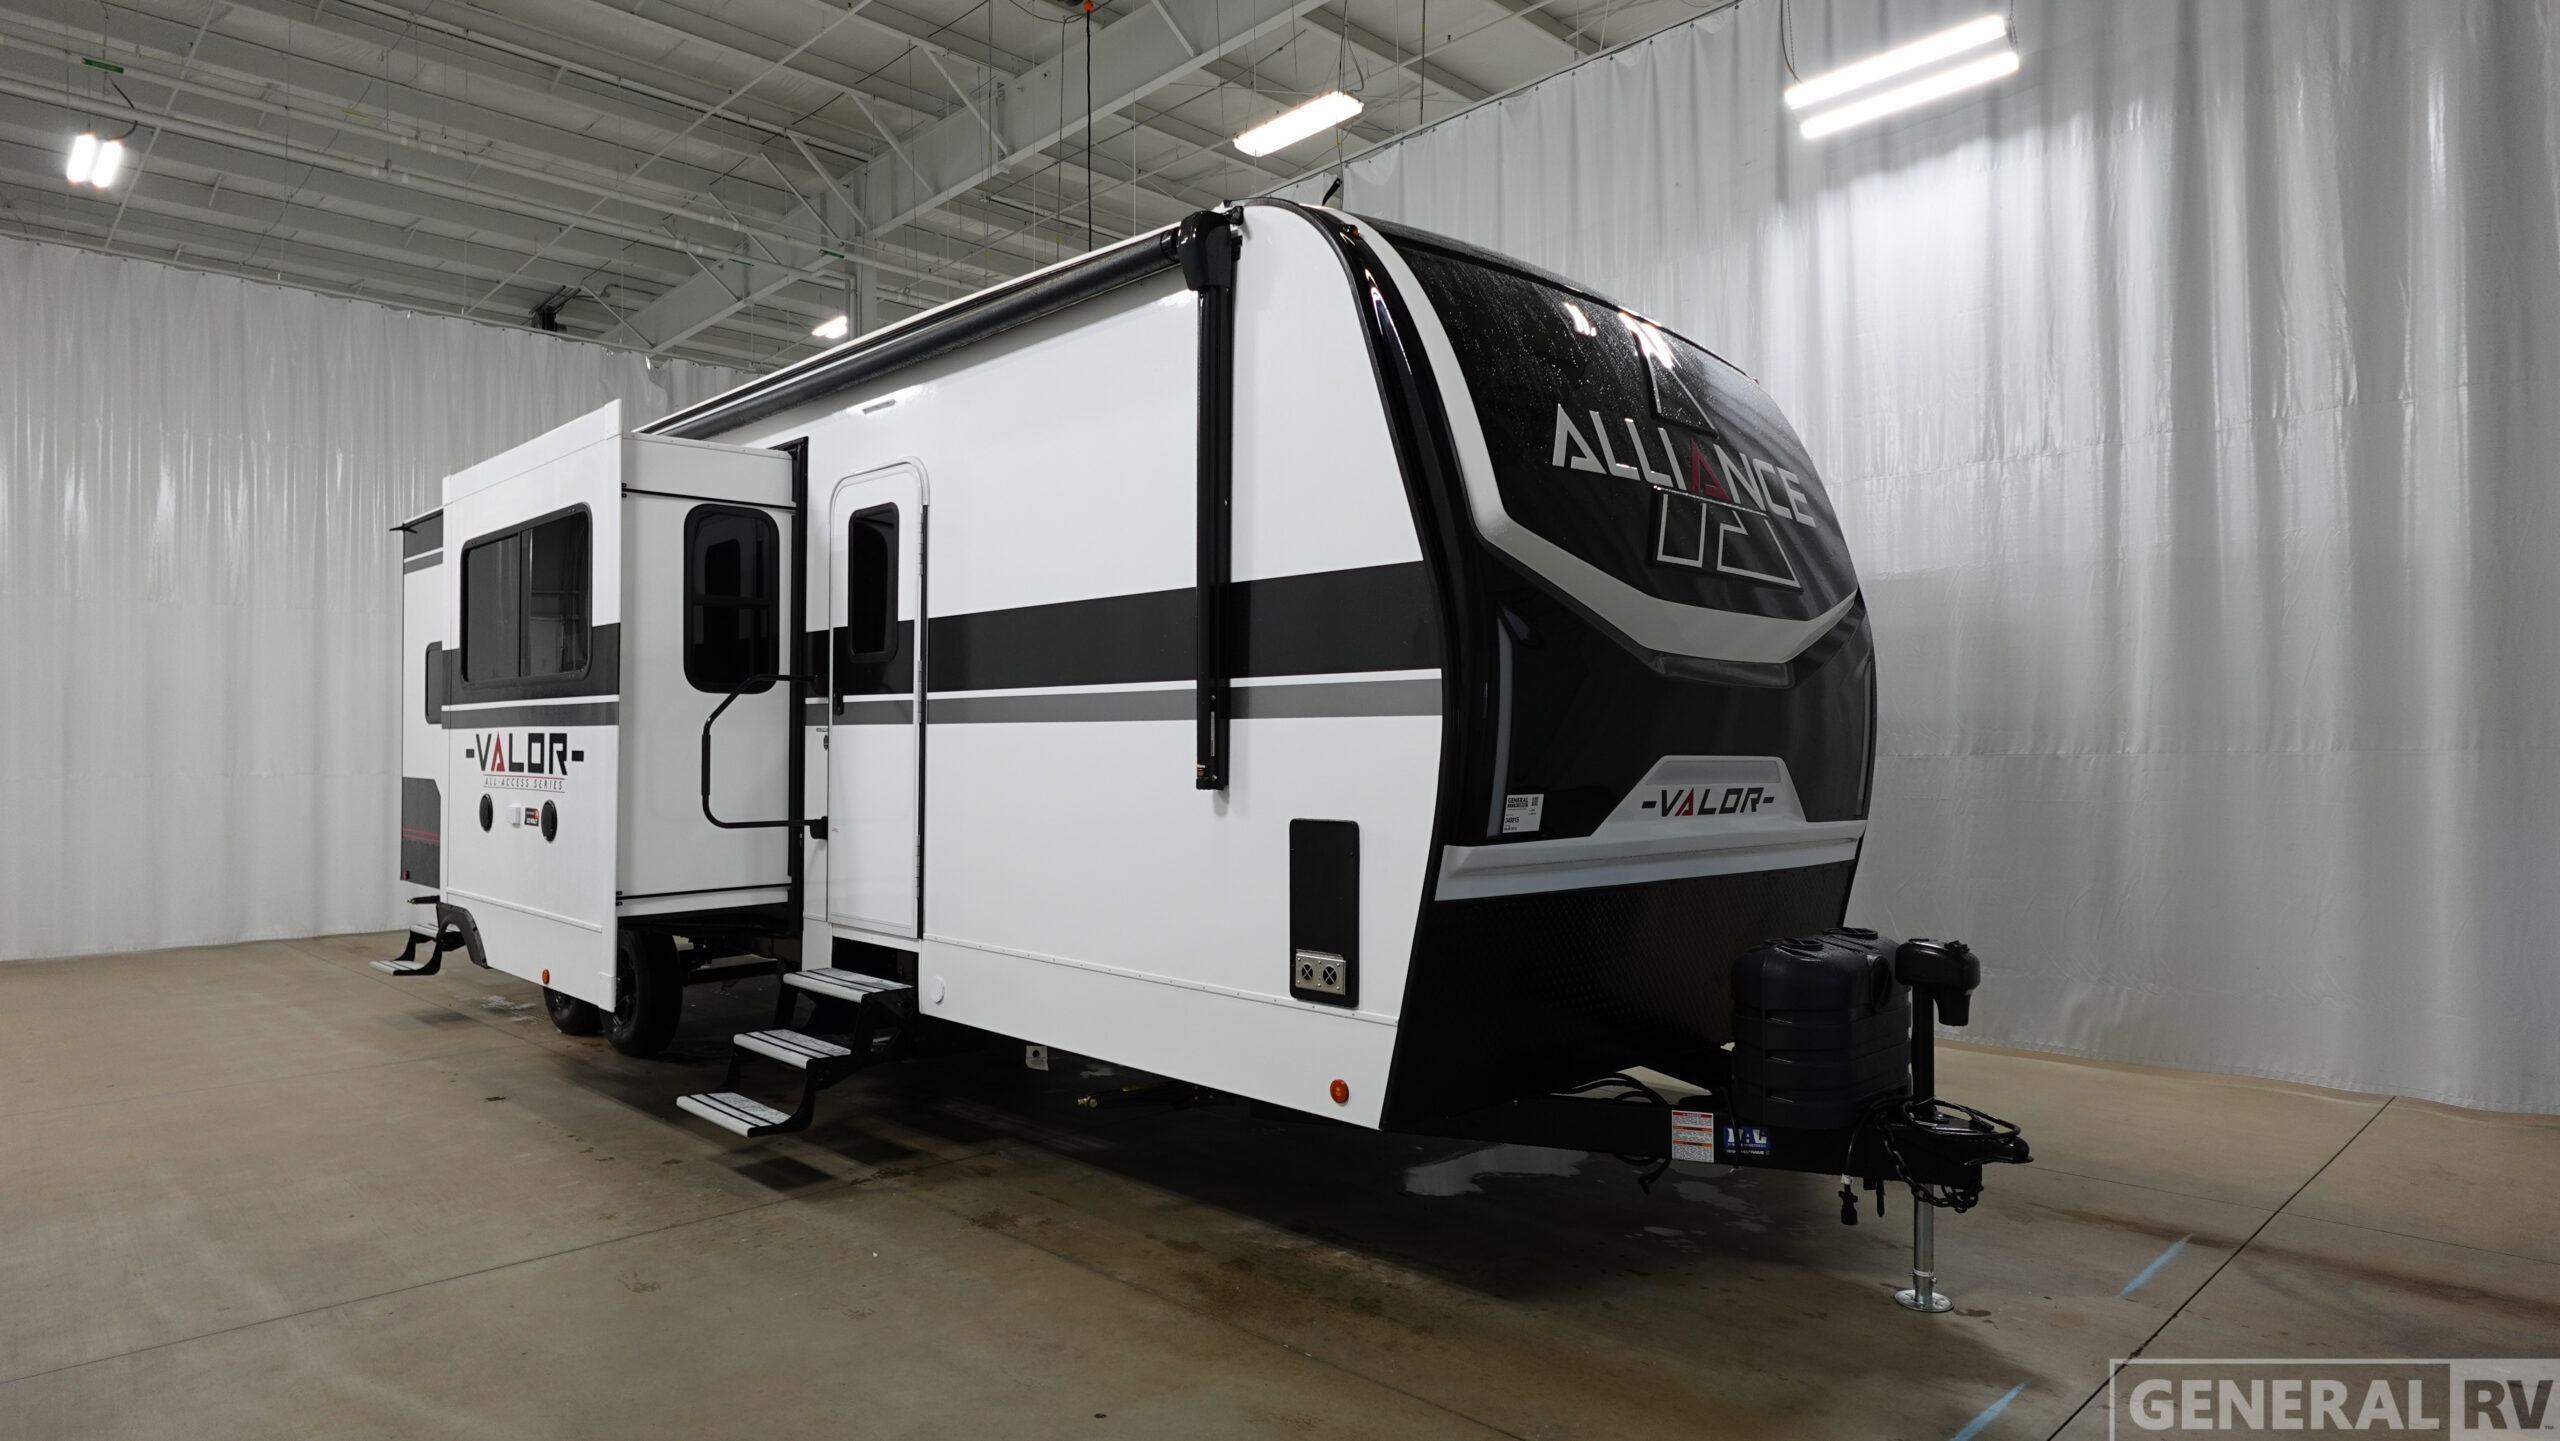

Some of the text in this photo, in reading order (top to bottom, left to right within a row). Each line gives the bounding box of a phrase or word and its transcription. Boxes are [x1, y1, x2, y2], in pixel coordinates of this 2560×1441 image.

[1552, 402, 1816, 527] ALLIANCE
[485, 777, 563, 790] ALL-ACCESS SERIES
